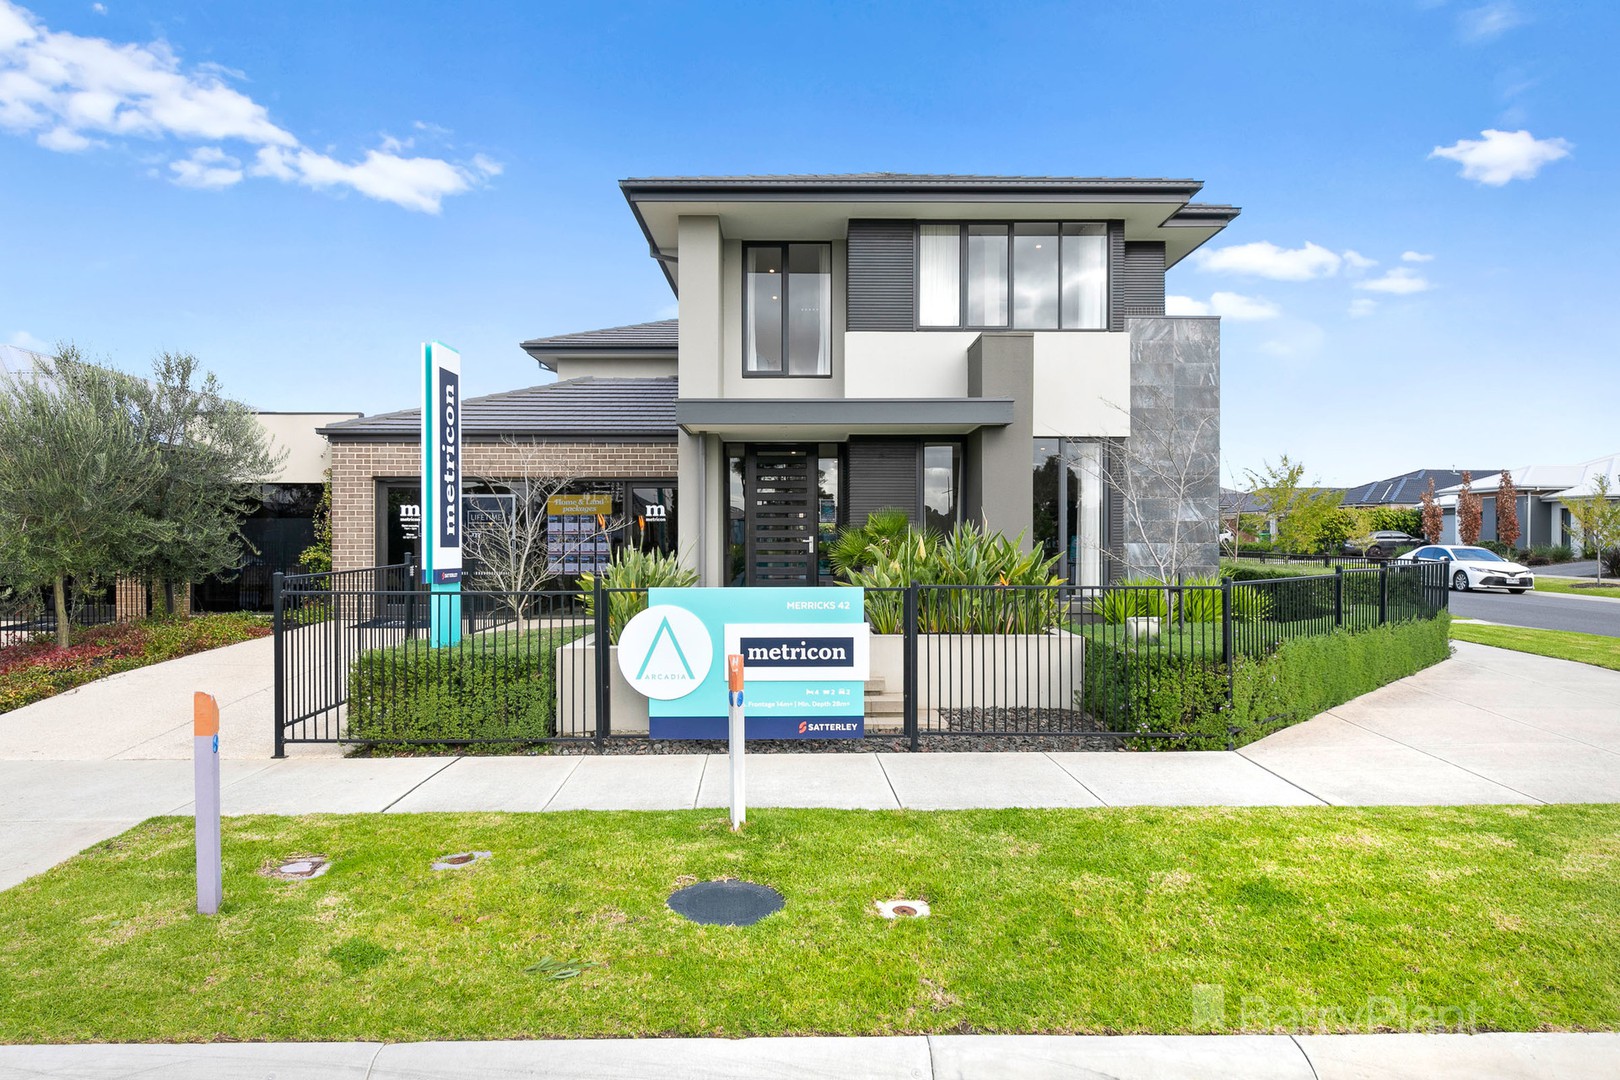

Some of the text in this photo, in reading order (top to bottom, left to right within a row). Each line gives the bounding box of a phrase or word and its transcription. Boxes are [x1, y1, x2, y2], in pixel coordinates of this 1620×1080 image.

[442, 384, 455, 536] metricon
[400, 504, 420, 516] m
[562, 505, 597, 513] packages
[645, 504, 666, 516] m
[786, 601, 850, 610] MERRICKS 42
[747, 641, 846, 661] metricon
[808, 723, 858, 731] SATTERLEY
